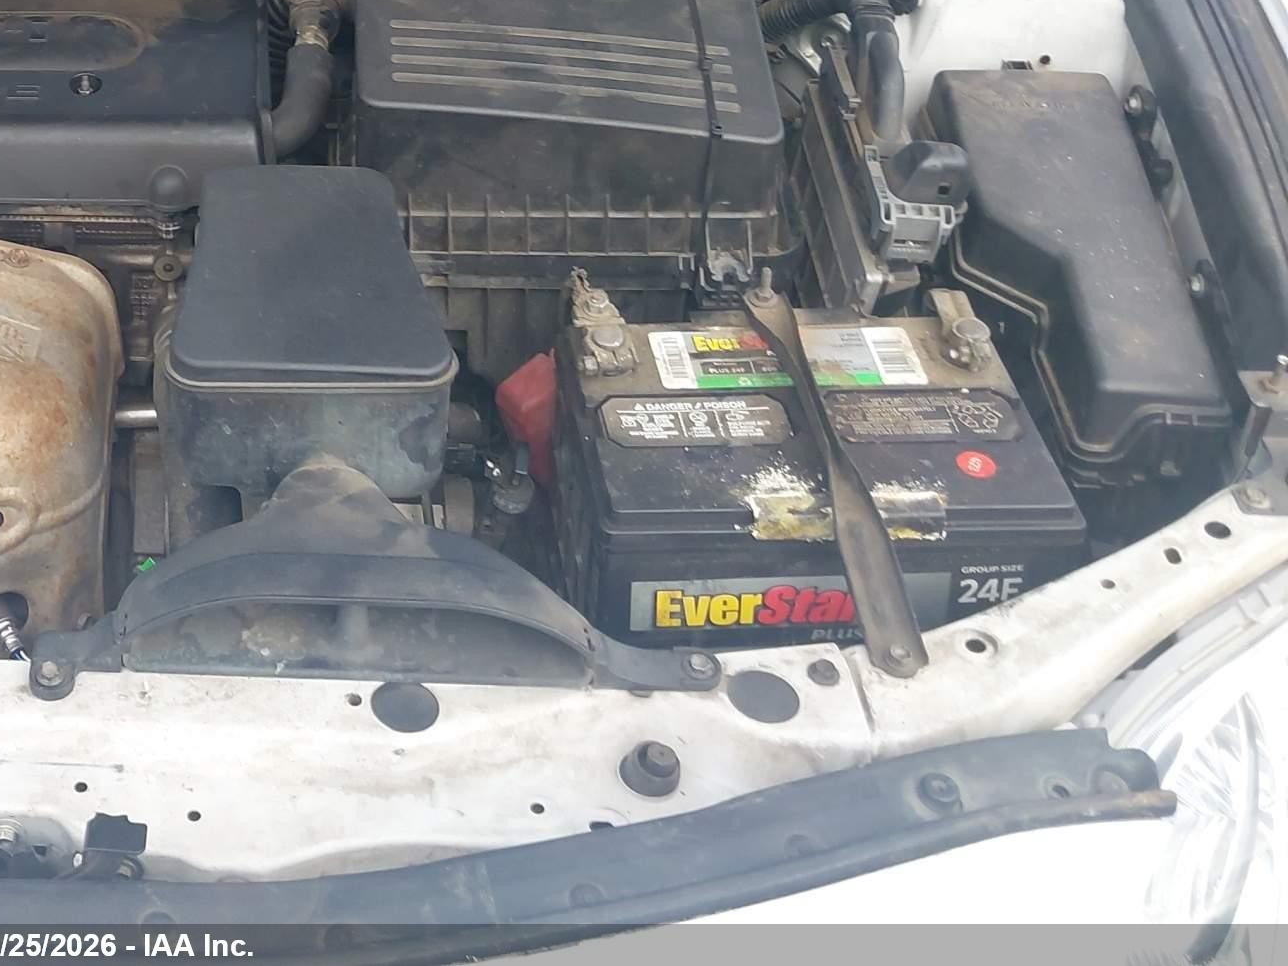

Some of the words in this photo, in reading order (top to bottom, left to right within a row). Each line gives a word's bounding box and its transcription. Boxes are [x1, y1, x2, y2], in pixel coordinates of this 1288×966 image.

[645, 402, 693, 412] DANGER
[703, 400, 748, 410] POISON
[960, 565, 1000, 575] GROUP
[1001, 564, 1025, 572] SIZE
[957, 576, 1024, 604] 24F
